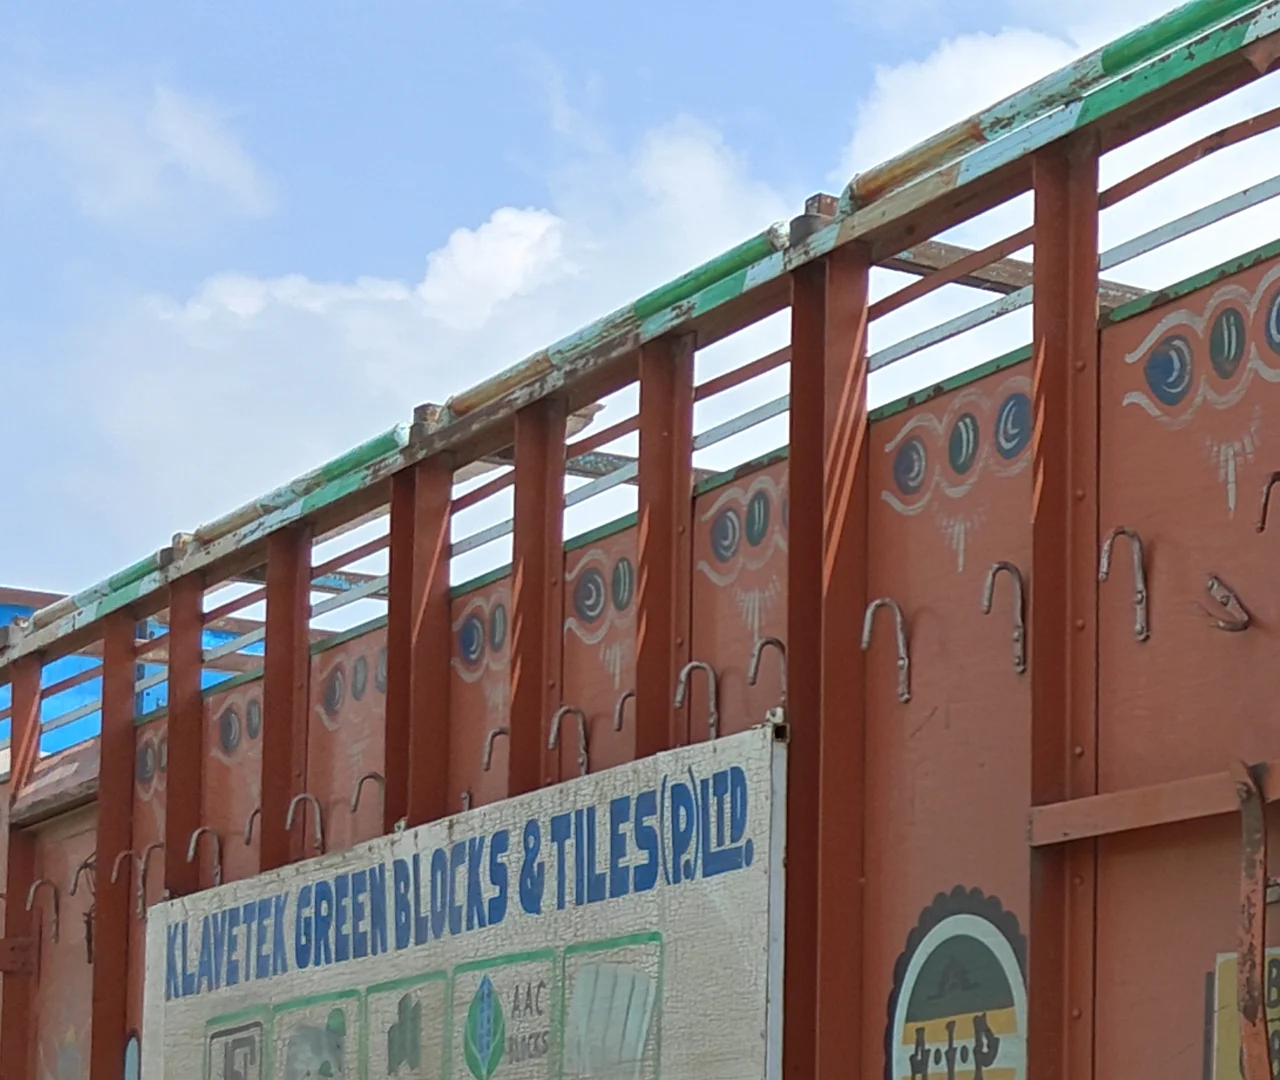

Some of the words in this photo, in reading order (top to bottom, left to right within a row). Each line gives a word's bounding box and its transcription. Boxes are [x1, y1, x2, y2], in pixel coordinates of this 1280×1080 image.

[166, 891, 288, 1000] KLAVETEK
[295, 862, 388, 969] GREEN
[394, 829, 509, 950] BLOCKS
[519, 818, 545, 915] &
[511, 979, 547, 1019] AAC
